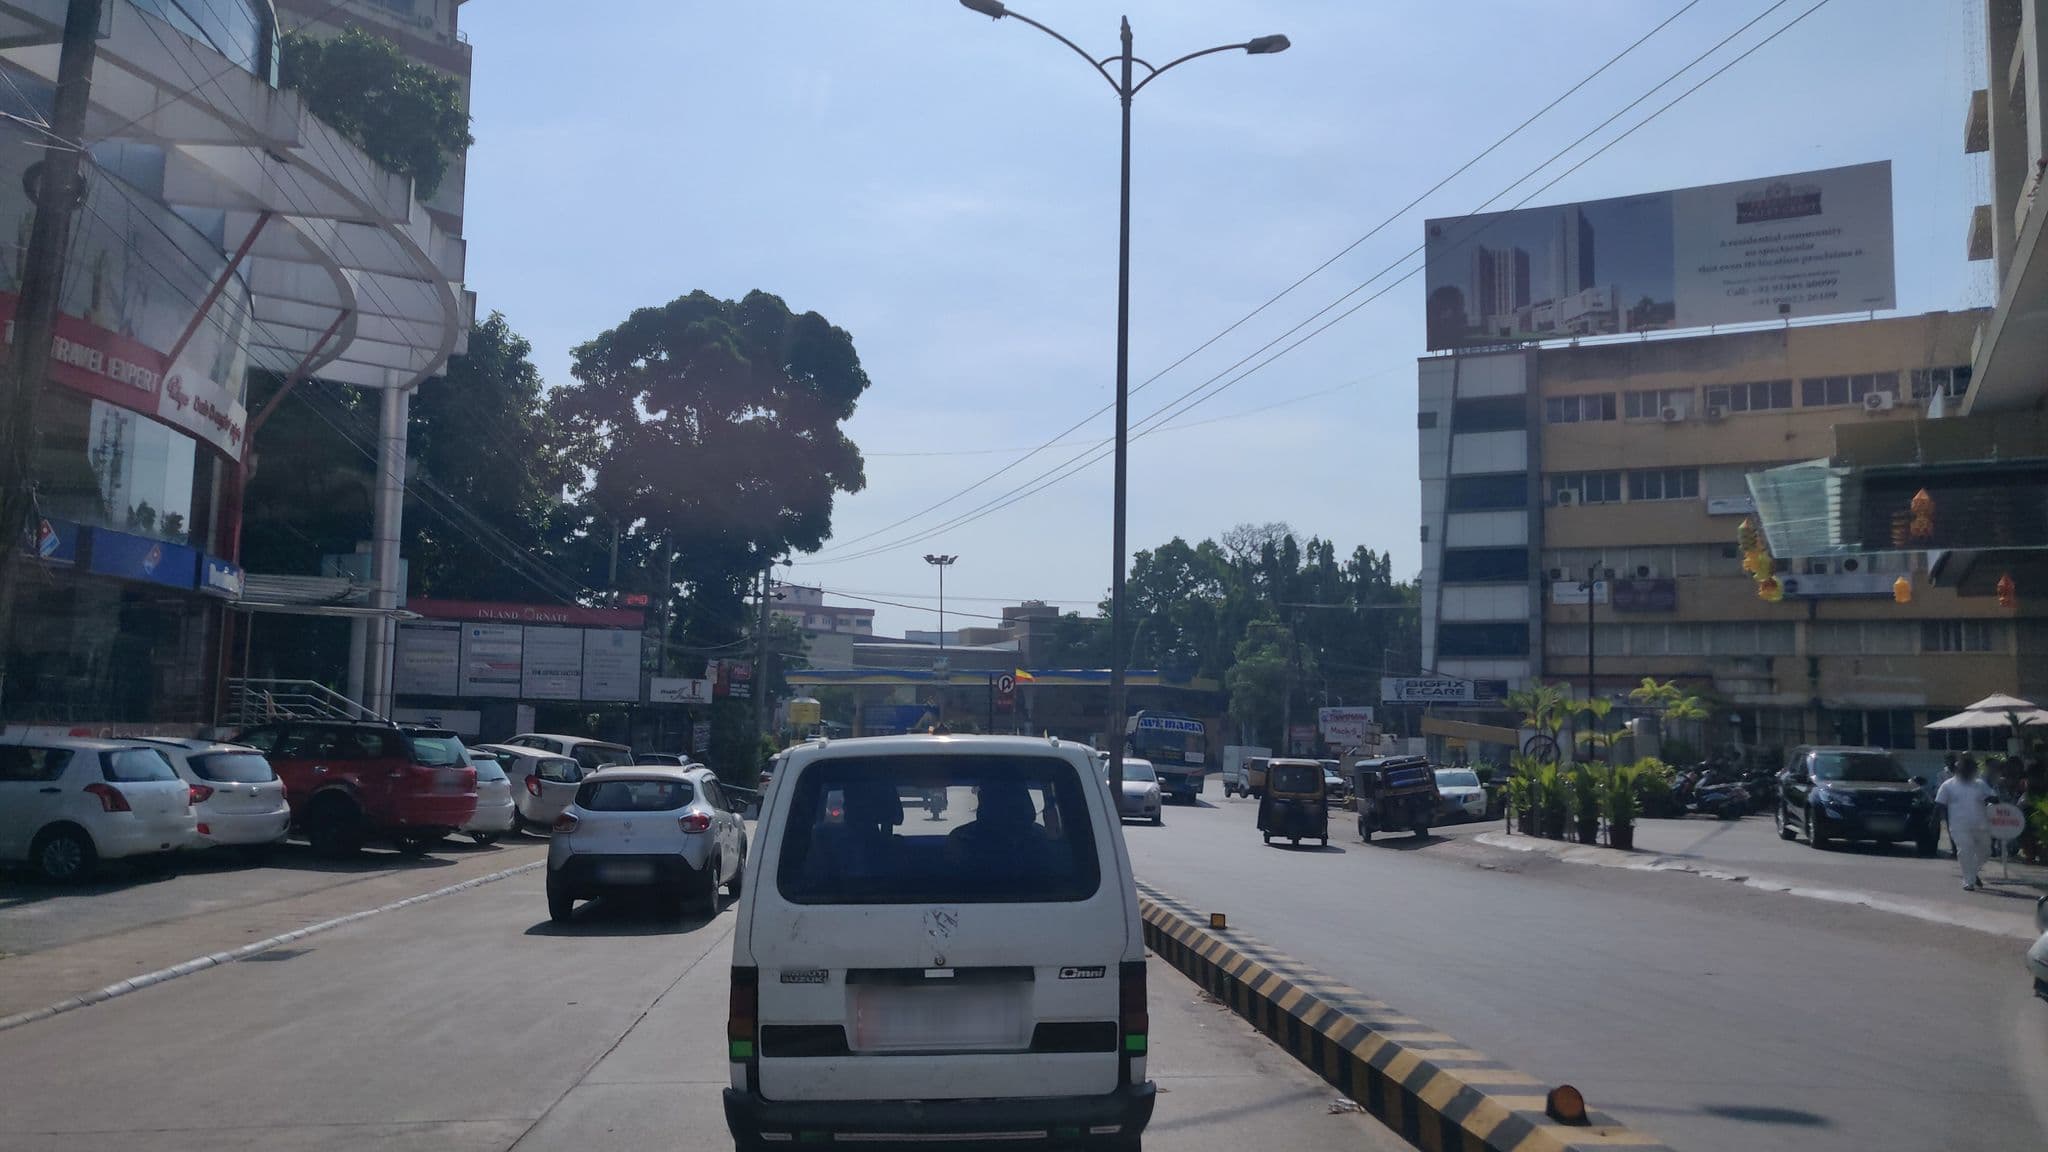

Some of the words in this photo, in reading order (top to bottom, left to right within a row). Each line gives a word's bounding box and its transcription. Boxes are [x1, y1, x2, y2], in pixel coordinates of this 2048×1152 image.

[108, 357, 161, 393] EXPERT
[478, 608, 518, 619] INLAND
[1406, 680, 1465, 688] BIGFIX
[1060, 967, 1104, 978] Omni
